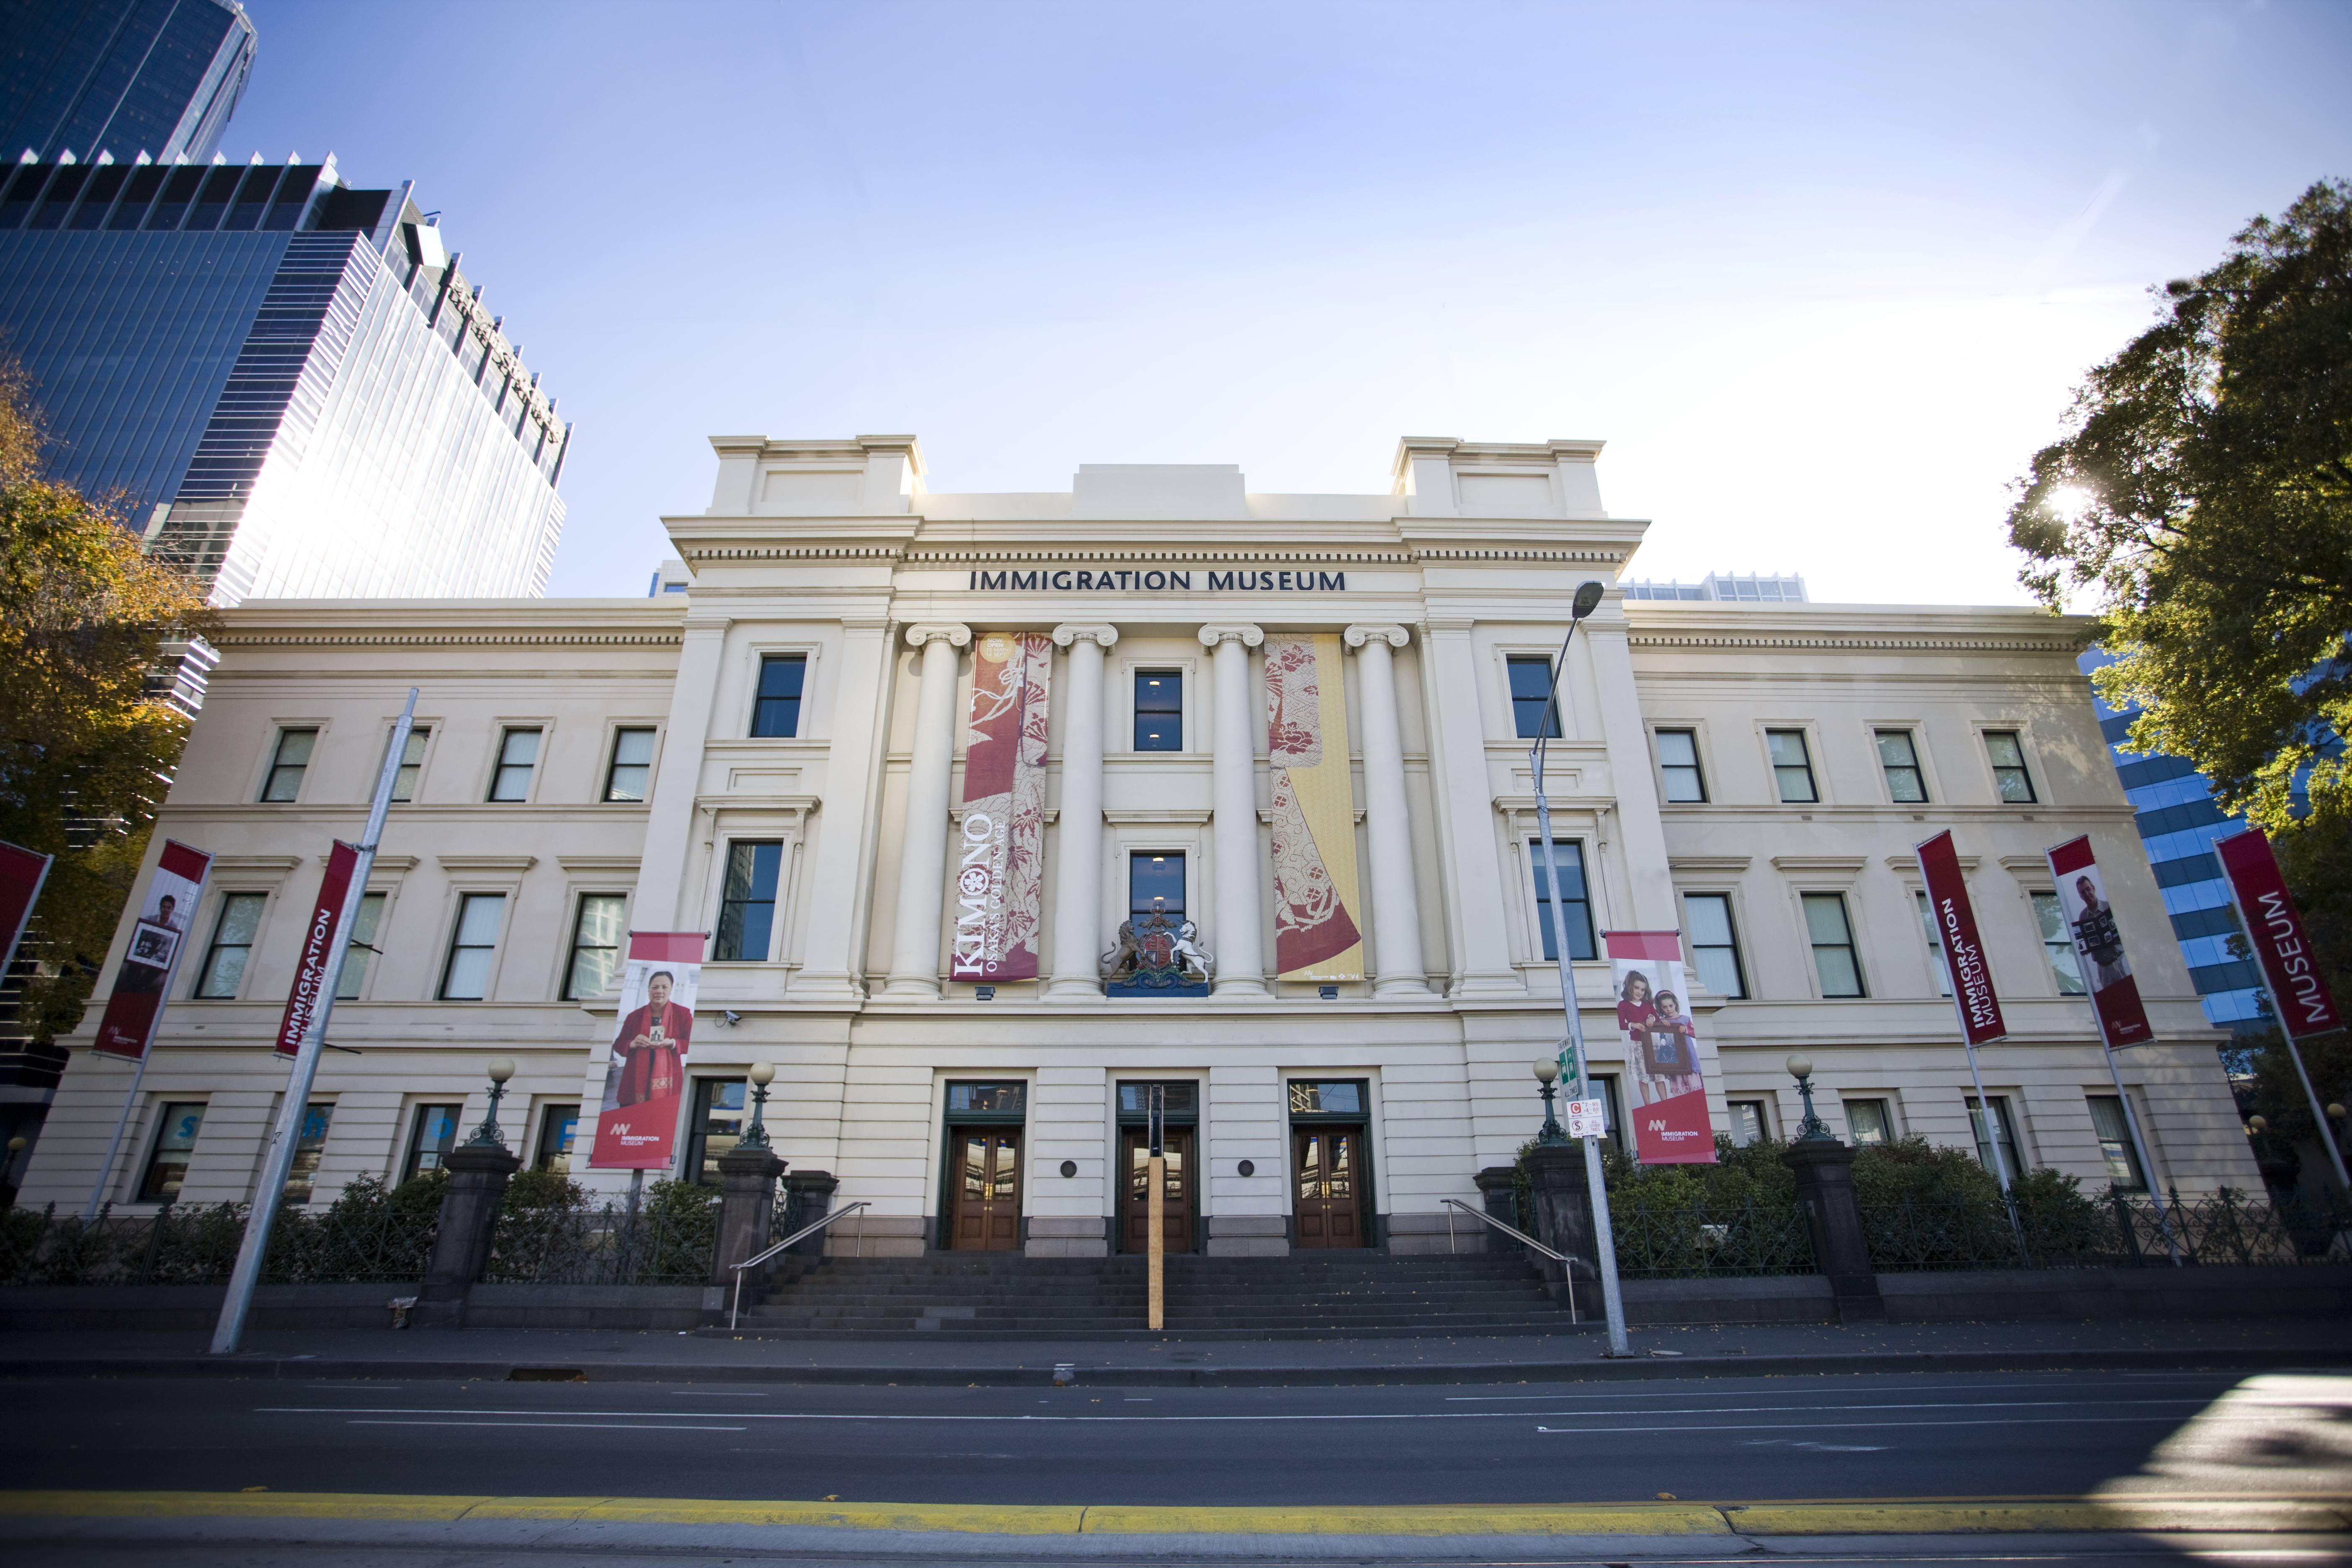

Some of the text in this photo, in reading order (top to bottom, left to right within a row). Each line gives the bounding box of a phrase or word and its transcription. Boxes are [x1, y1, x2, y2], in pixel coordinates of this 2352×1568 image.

[970, 570, 1345, 591] IMMIGRATION MUSEUM
[994, 820, 1006, 848] AGE
[954, 813, 993, 977] KIMONO
[990, 851, 1004, 910] GOLDEN
[284, 908, 331, 1046] IMMIGRATION
[1942, 898, 1985, 1029] IMMIGRATION
[1965, 944, 1996, 1025] MUSEUM
[2258, 891, 2329, 1023] MUSEUM
[1558, 1037, 1570, 1052] FAIRWAY
